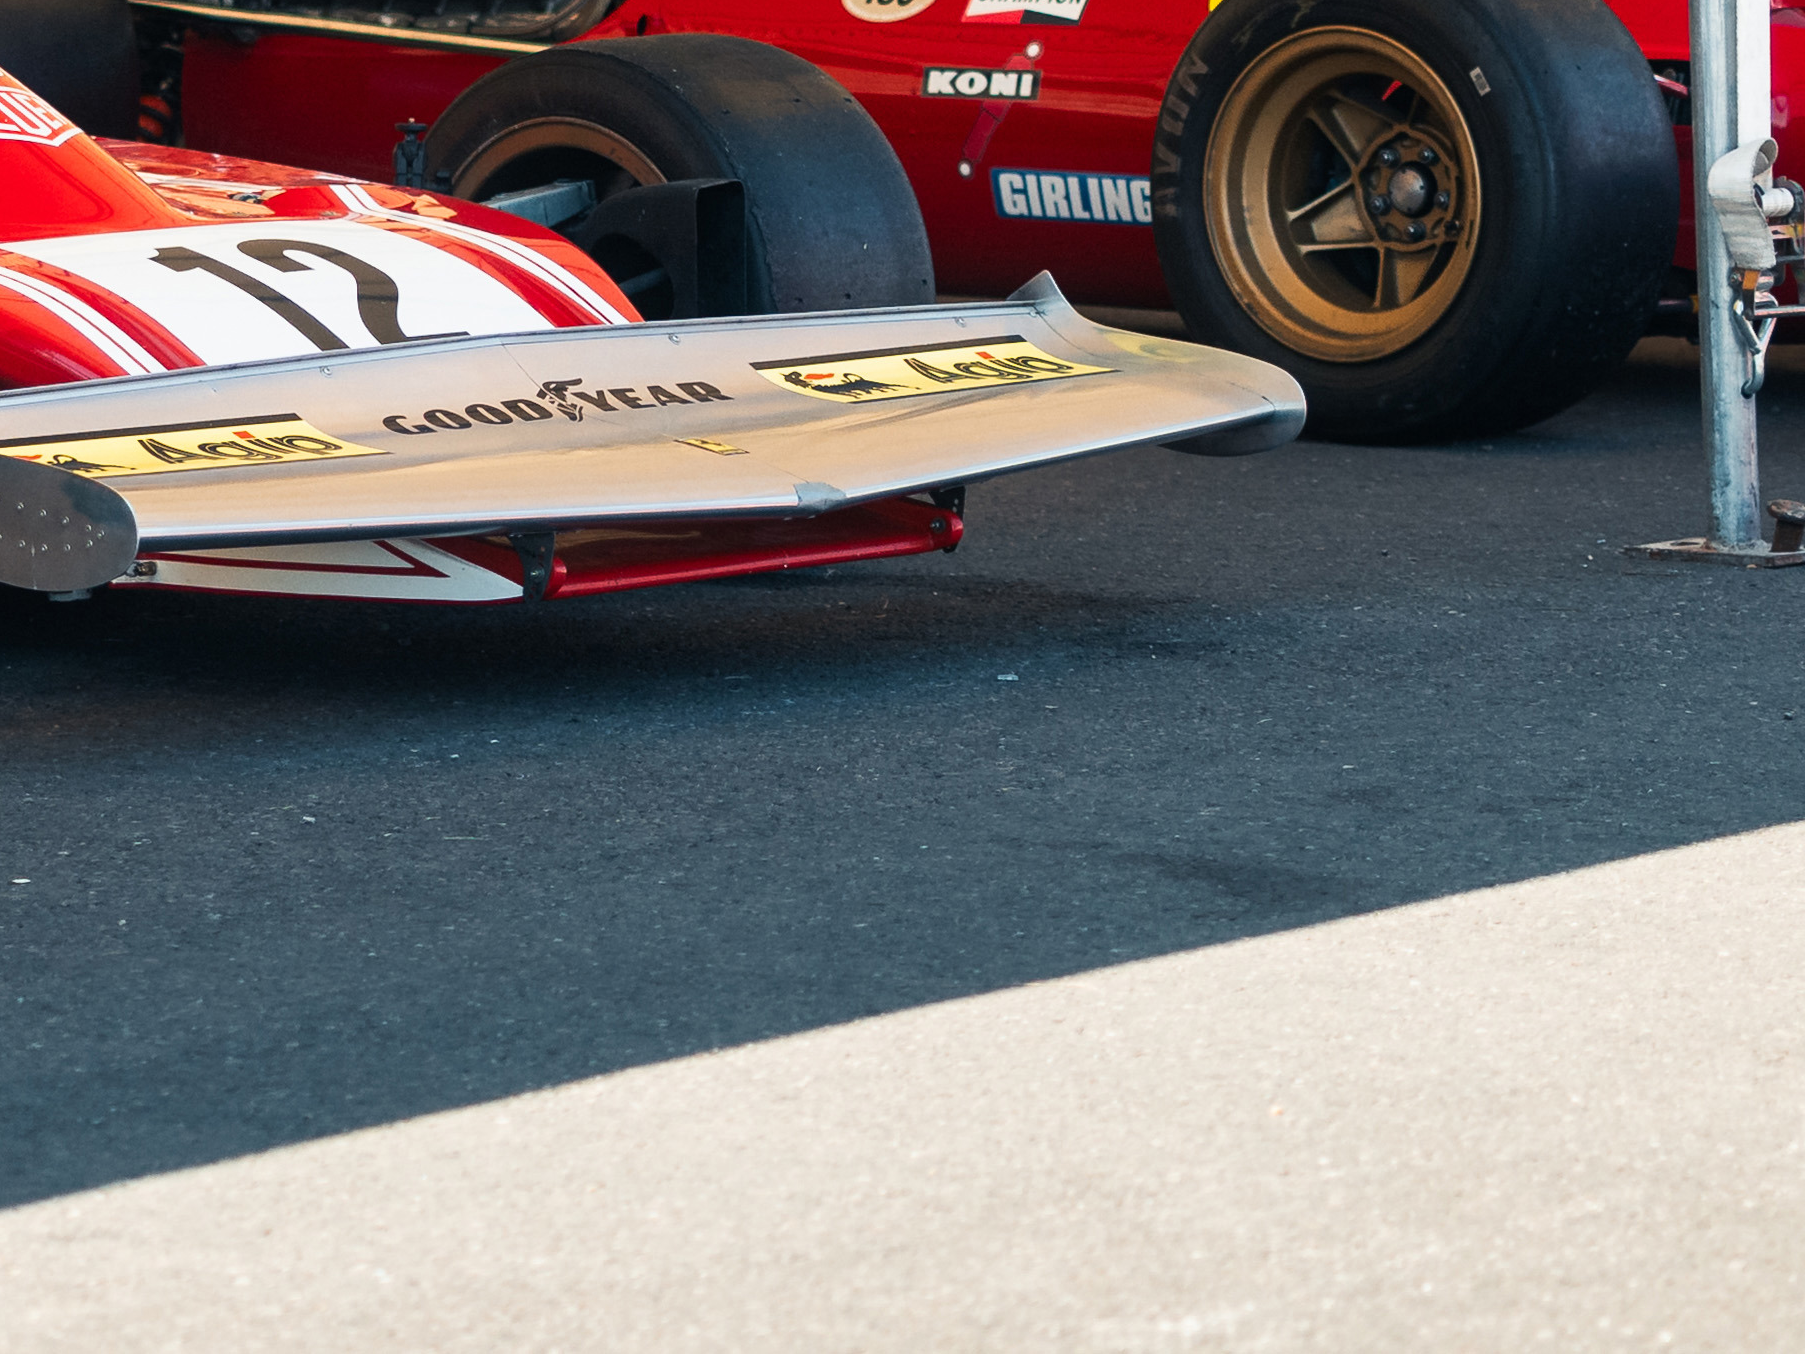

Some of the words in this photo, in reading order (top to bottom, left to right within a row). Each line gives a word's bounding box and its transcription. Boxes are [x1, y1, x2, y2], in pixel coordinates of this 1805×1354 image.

[927, 70, 1034, 97] KONI
[998, 172, 1152, 223] GIRLING
[147, 239, 471, 352] 12
[910, 351, 1077, 386] Agip
[138, 430, 343, 464] Agip
